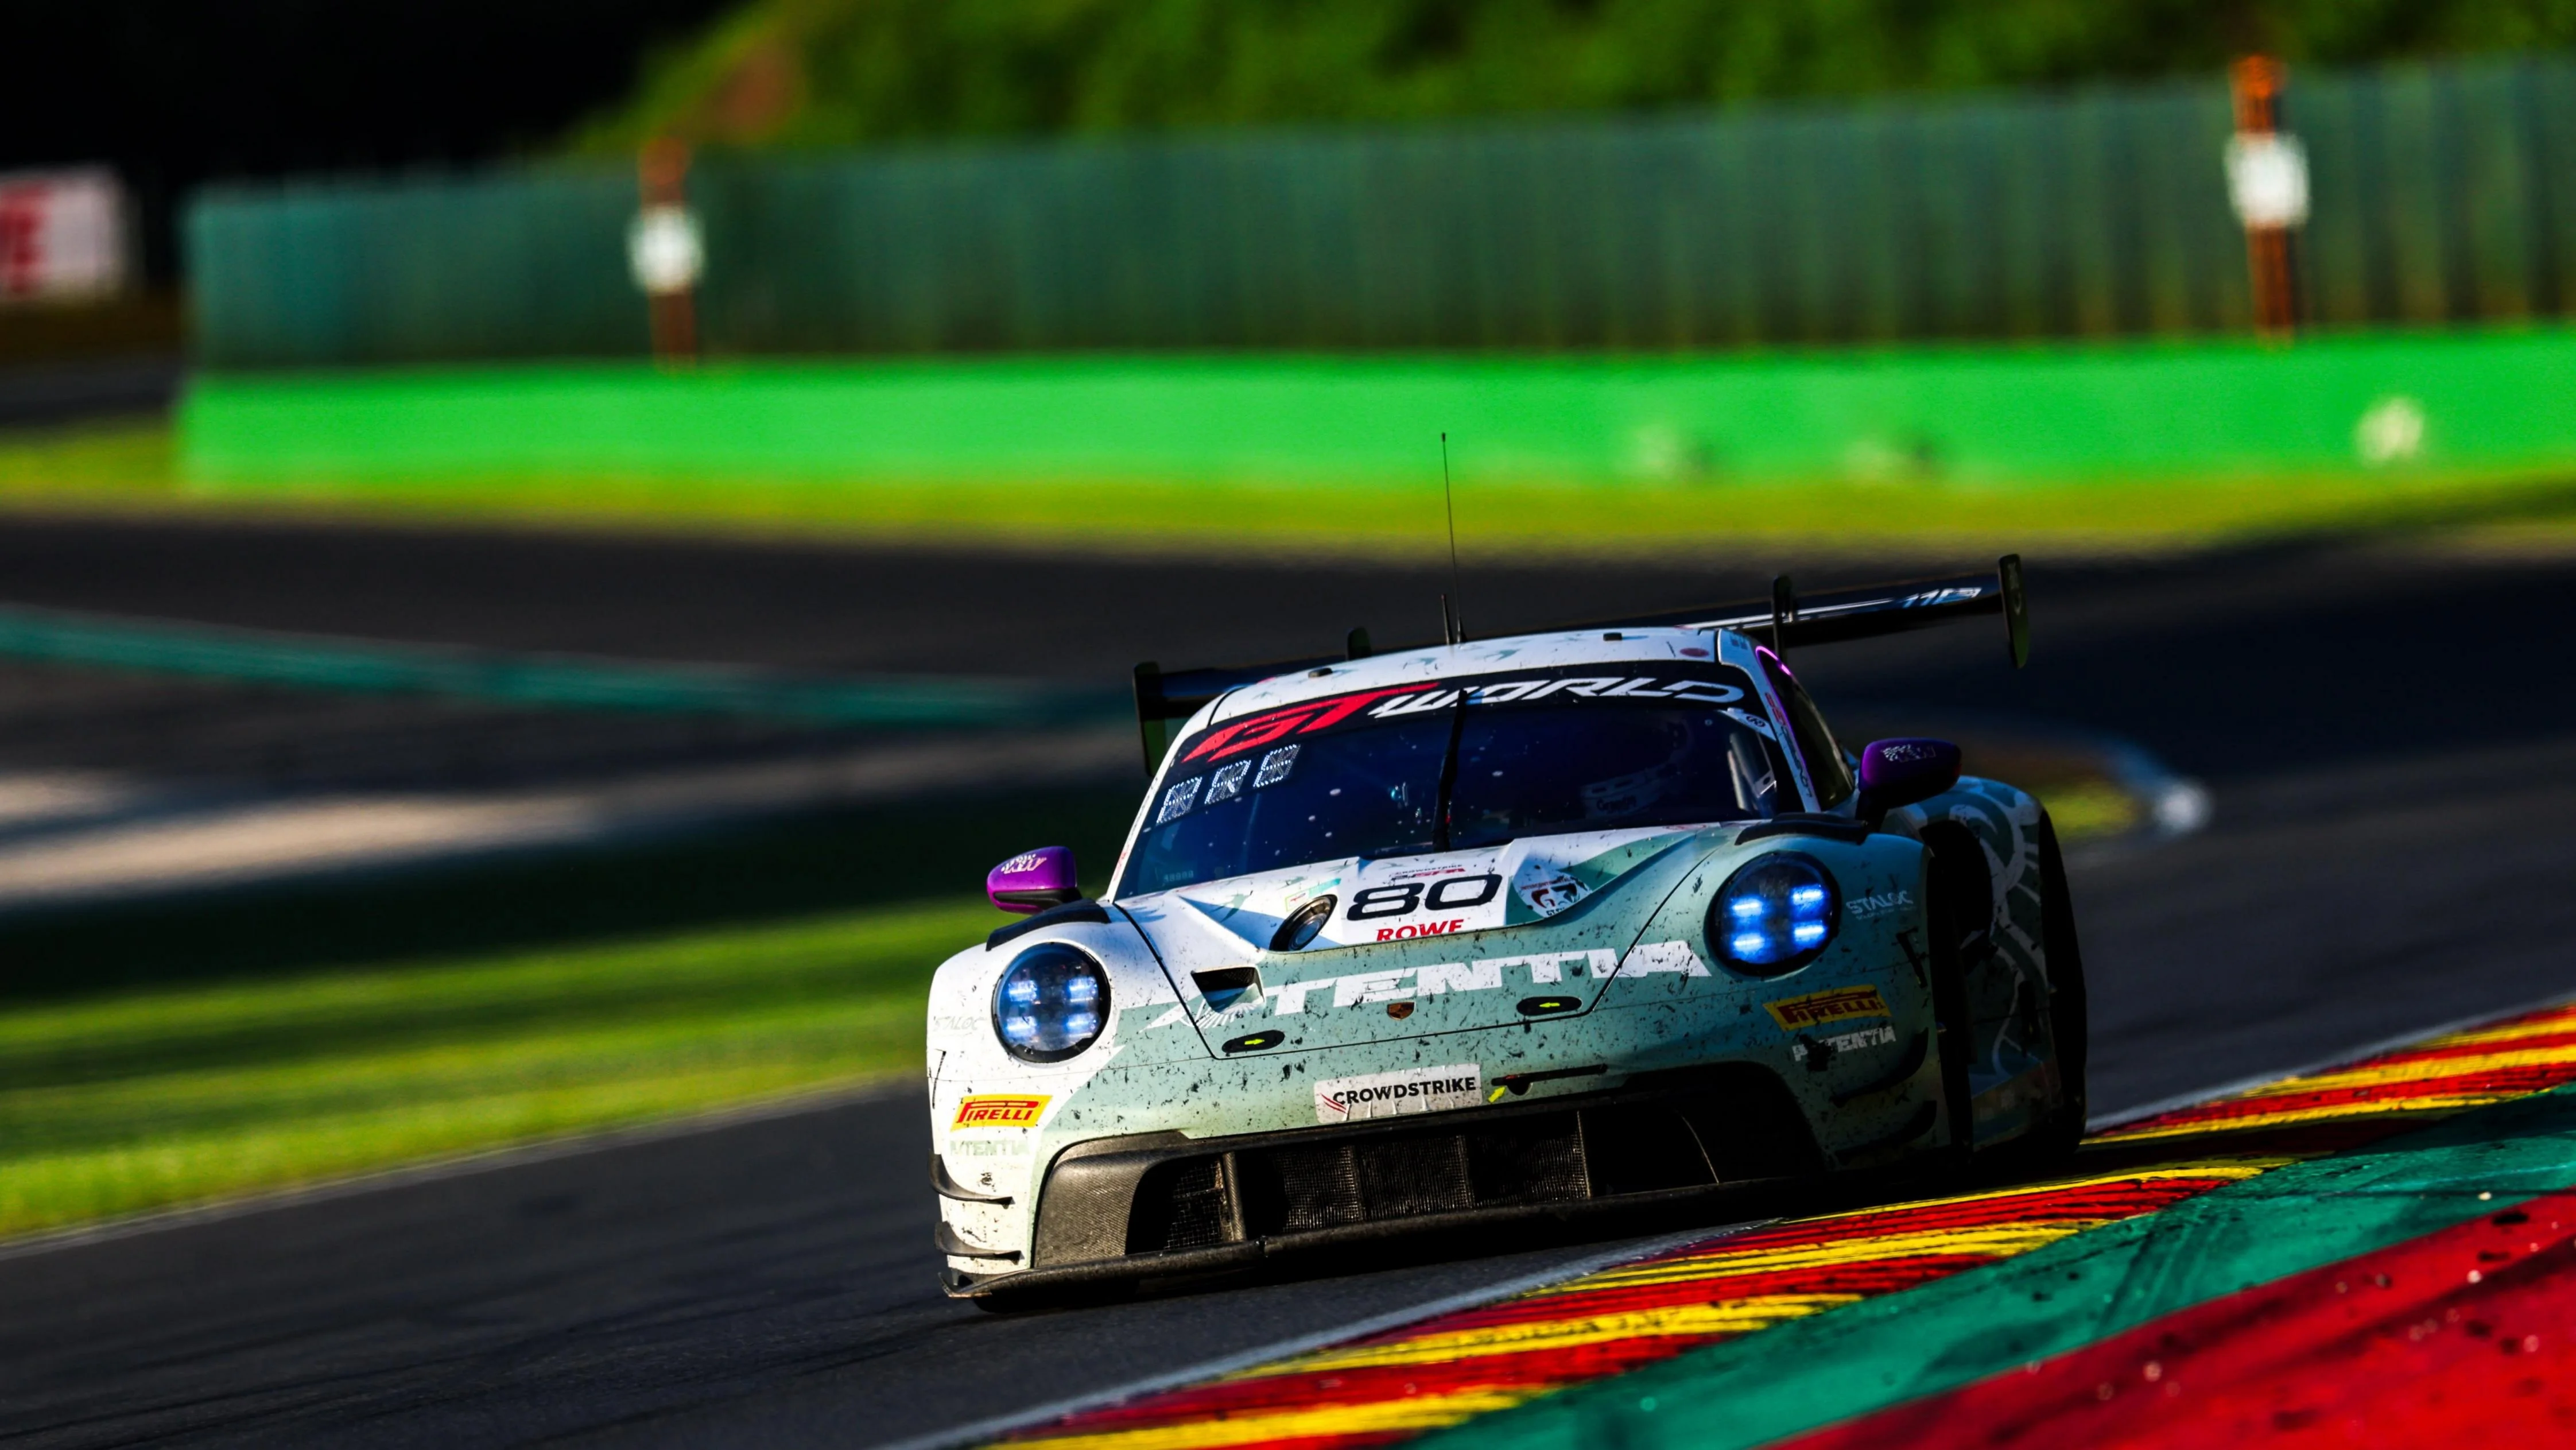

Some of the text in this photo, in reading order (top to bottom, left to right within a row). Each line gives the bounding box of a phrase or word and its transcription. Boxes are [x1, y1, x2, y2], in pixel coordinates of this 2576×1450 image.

[1367, 677, 1745, 719] WORLD
[1347, 874, 1502, 921] 80
[1777, 991, 1877, 1025] PIRELLI
[1792, 1026, 1896, 1061] PTENTIA
[1333, 1076, 1477, 1105] CROWDSTRIKE
[956, 1100, 1039, 1123] PIRELLI
